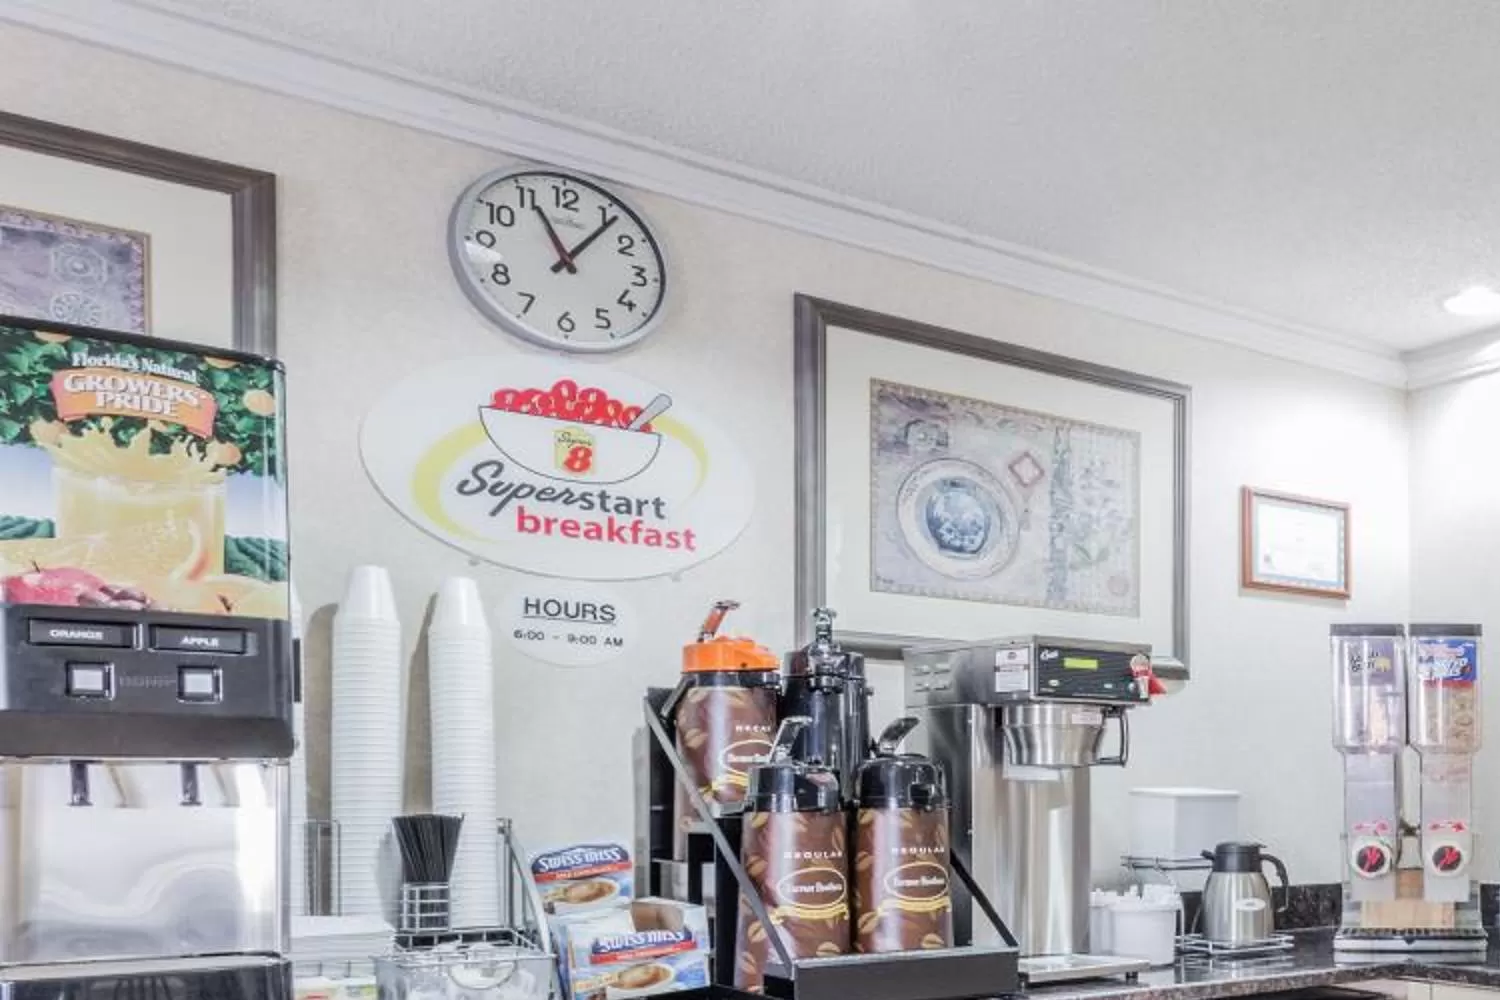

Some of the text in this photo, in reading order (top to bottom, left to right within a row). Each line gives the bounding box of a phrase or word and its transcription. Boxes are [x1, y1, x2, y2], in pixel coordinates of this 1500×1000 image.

[515, 185, 536, 211] 11
[552, 185, 579, 212] 12
[486, 201, 515, 227] 10
[617, 235, 634, 256] 2
[491, 263, 511, 286] 8
[631, 265, 648, 287] 3
[517, 292, 536, 314] 7
[617, 289, 636, 311] 4
[557, 311, 575, 332] 6
[594, 308, 611, 329] 5
[140, 357, 197, 383] Natural
[95, 391, 179, 417] PRIDE
[564, 446, 593, 473] 8
[456, 460, 667, 519] Superstart
[516, 505, 697, 551] breakfast
[524, 596, 616, 621] HOURS
[50, 628, 103, 641] ORANGE
[180, 636, 220, 648] APPLE
[513, 629, 545, 640] 6:00
[567, 633, 597, 645] 9:00
[603, 636, 624, 647] AM
